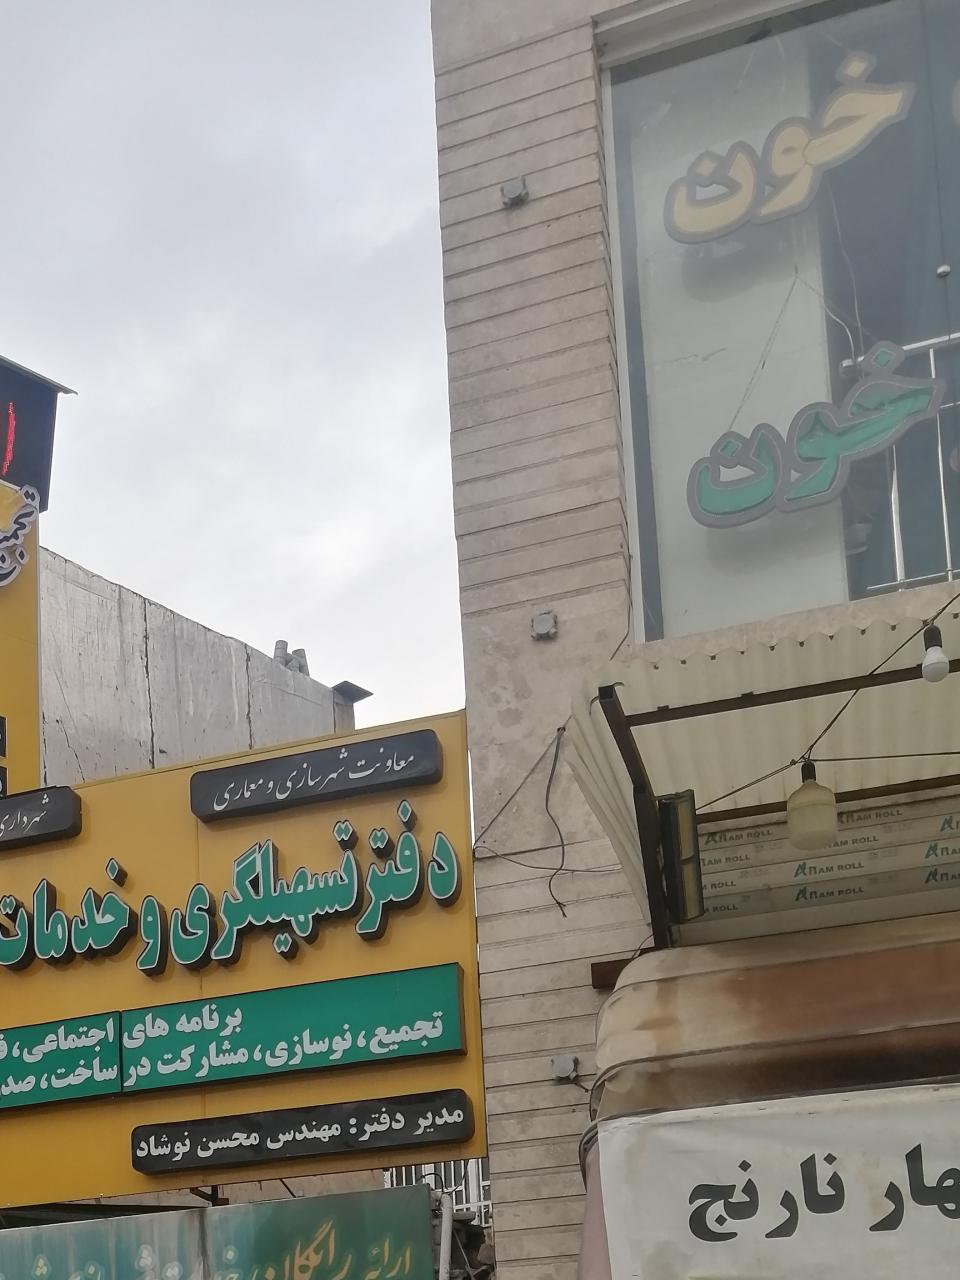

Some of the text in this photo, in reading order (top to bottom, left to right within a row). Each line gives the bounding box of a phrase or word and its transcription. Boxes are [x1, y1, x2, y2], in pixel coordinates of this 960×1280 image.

[348, 746, 415, 779] معاونت
[213, 776, 264, 811] معماری
[852, 836, 879, 845] ROLL
[355, 800, 459, 936] دفتر
[725, 855, 751, 864] ROLL
[837, 861, 865, 871] ROLL
[170, 819, 360, 966] تسهیلگری
[711, 881, 737, 890] ROLL
[838, 887, 865, 897] ROLL
[713, 904, 738, 913] ROLL
[136, 894, 162, 971] و
[122, 1012, 169, 1050] های
[176, 1004, 242, 1037] برنامه
[123, 1055, 151, 1088] در
[157, 1040, 250, 1077] مشارکت
[266, 1118, 342, 1150] مهندس
[413, 1107, 465, 1136] مدیر
[136, 1130, 192, 1163] نوشاد
[197, 1125, 260, 1159] محسن
[689, 1152, 845, 1243] نارنج
